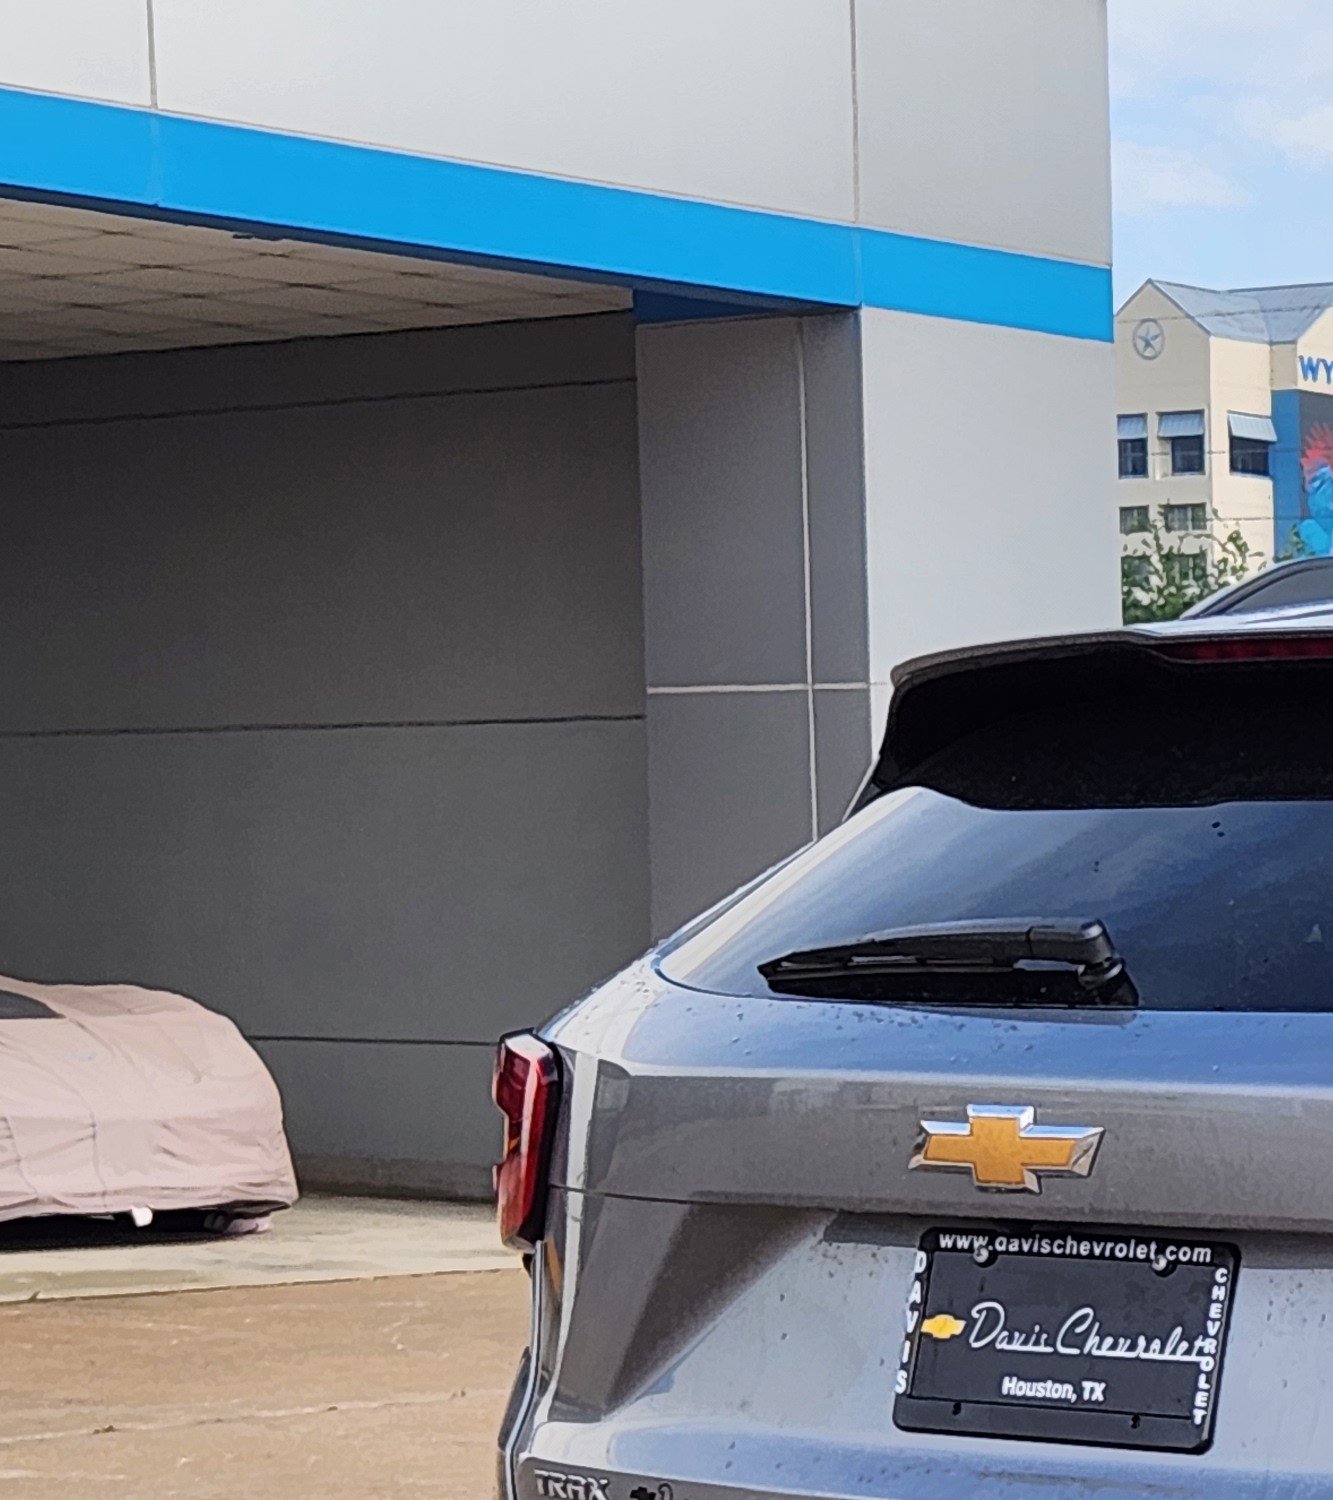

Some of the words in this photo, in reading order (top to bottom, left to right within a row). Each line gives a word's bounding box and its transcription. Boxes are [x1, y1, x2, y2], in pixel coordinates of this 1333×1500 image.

[894, 1250, 928, 1395] DAVIS
[969, 1301, 1055, 1353] Davis
[1055, 1306, 1206, 1362] Chevrolet
[1192, 1267, 1229, 1425] CHEVROLET
[1001, 1375, 1078, 1404] Houston,
[1081, 1380, 1107, 1402] TX
